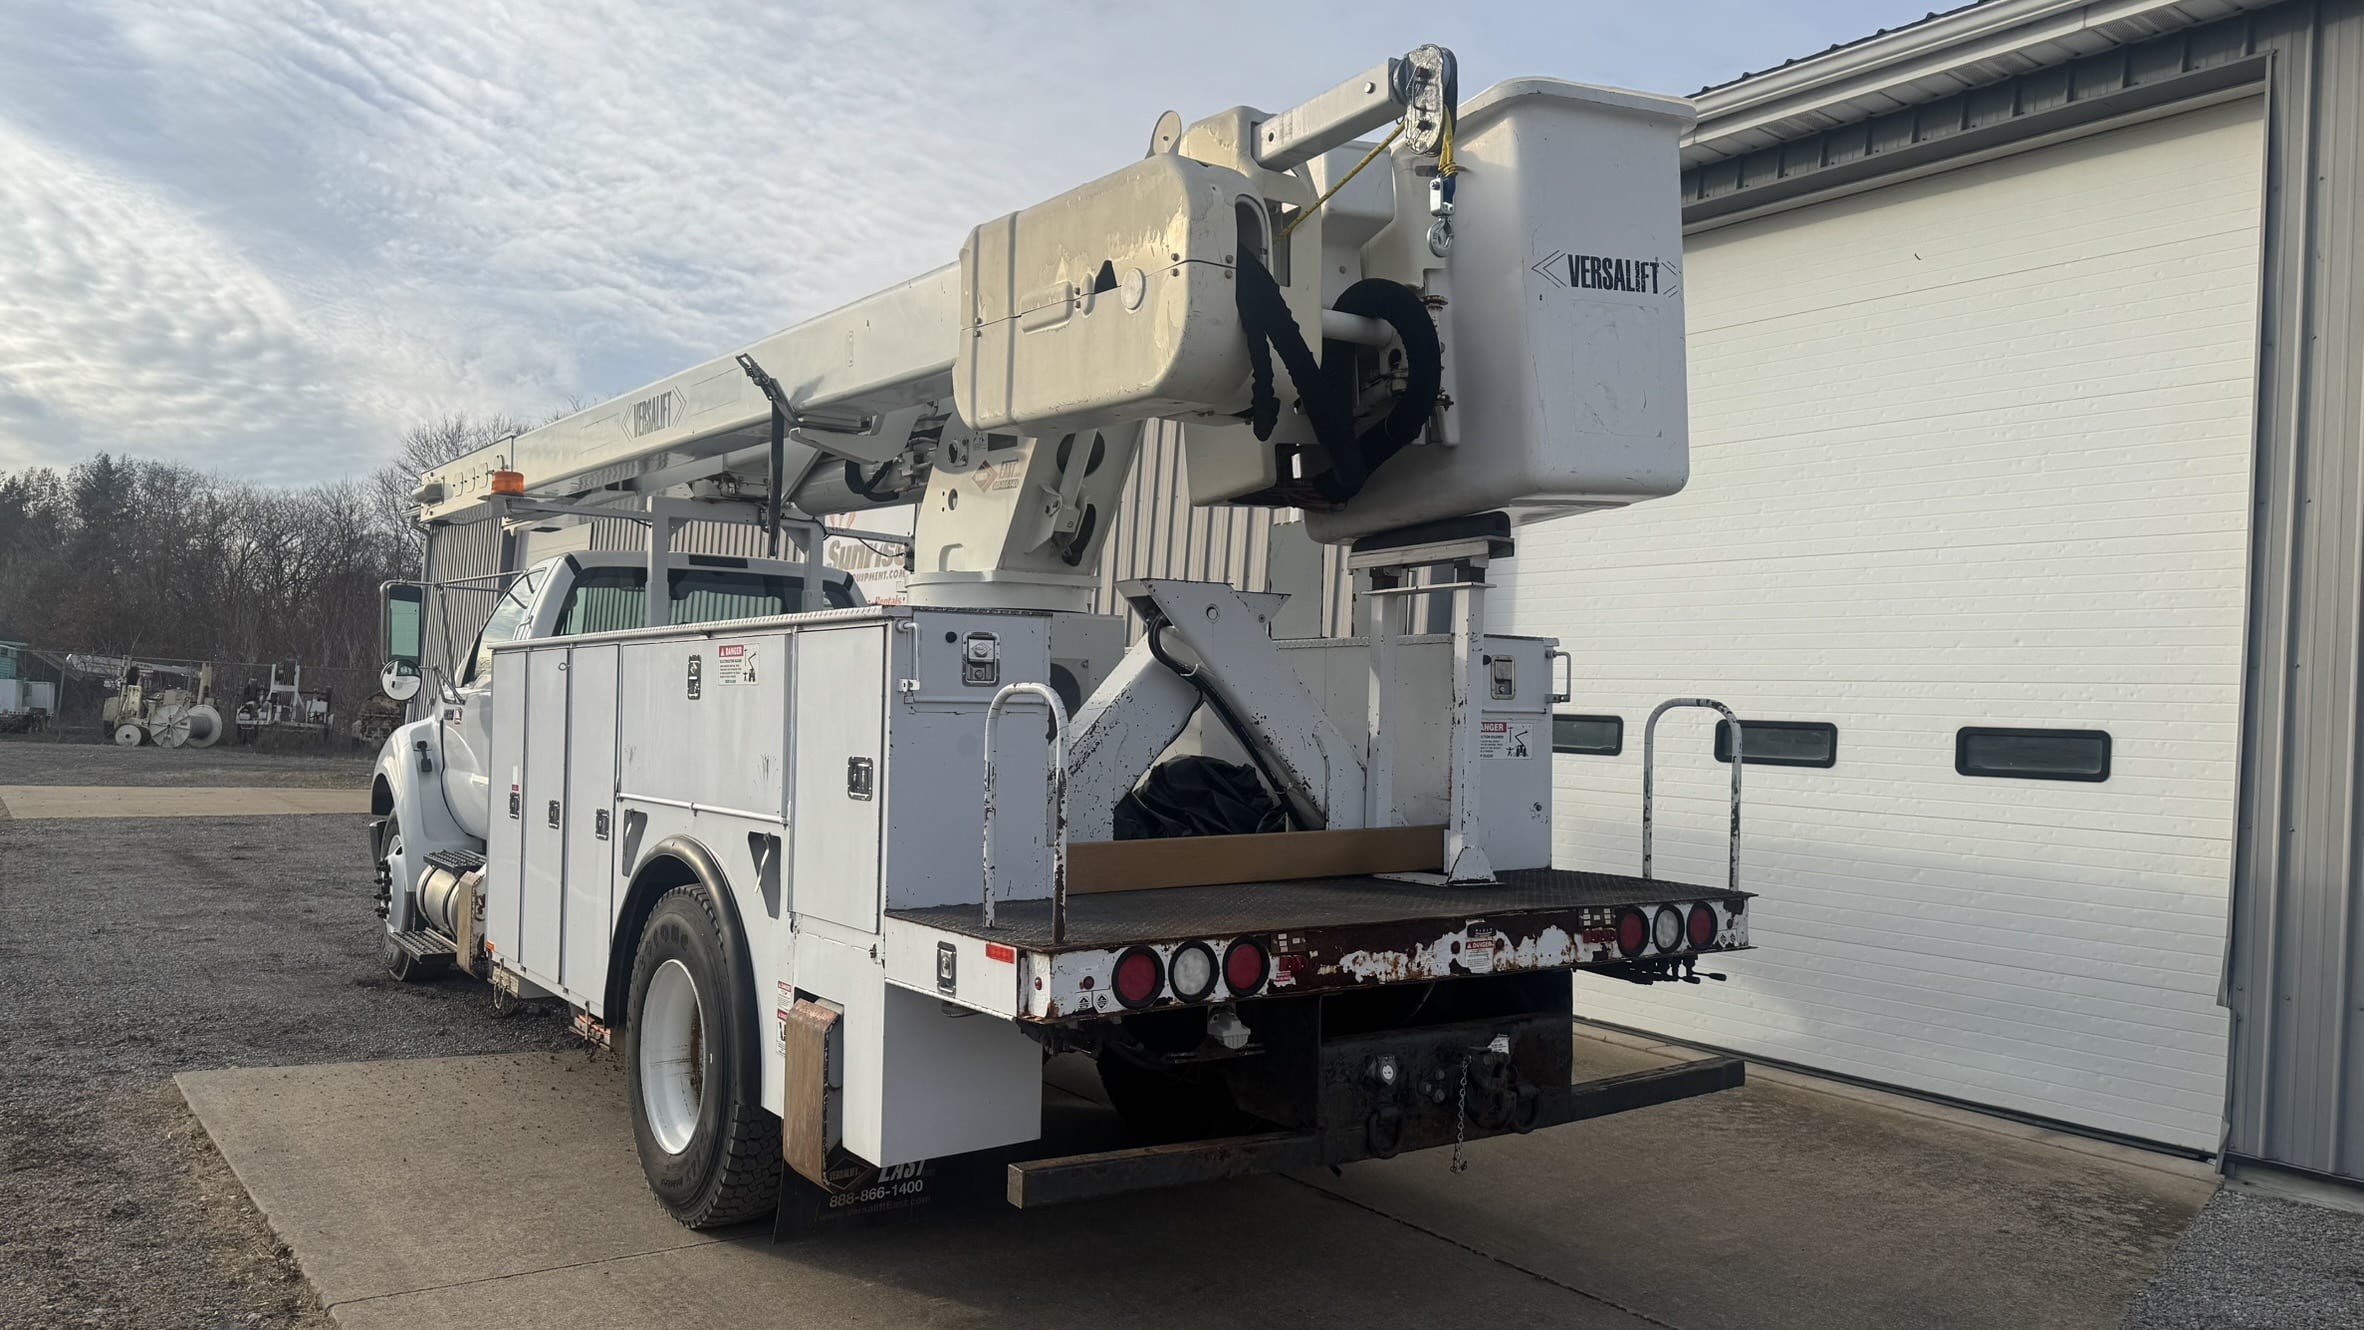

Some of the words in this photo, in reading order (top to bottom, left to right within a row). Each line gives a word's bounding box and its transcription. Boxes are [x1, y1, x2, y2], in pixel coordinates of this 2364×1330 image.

[1567, 254, 1659, 294] VERSALIFT
[633, 391, 672, 438] VERSALIFT
[829, 1179, 924, 1208] 888-866-1400
